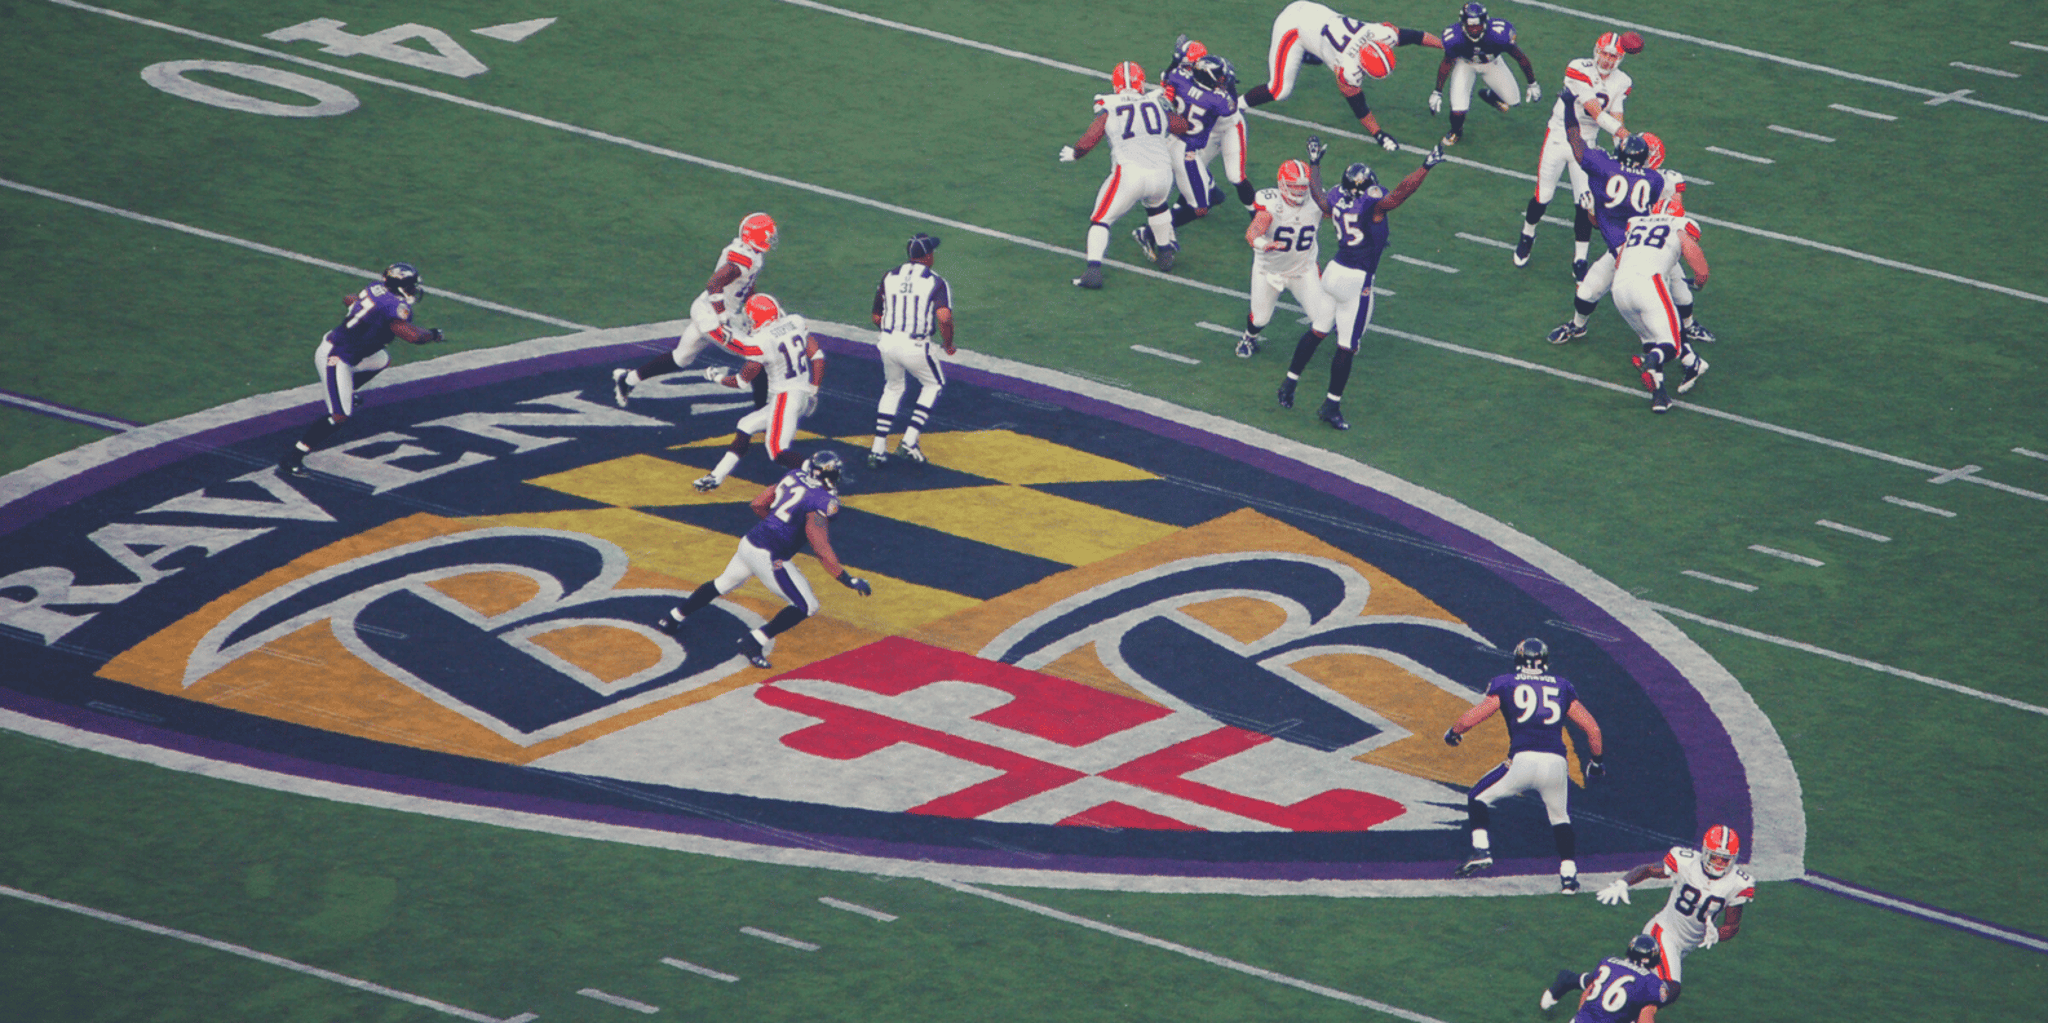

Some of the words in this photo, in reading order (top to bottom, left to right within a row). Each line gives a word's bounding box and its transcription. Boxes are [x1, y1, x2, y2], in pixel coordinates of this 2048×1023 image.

[1115, 102, 1162, 139] 70
[1604, 174, 1650, 213] 90
[900, 282, 913, 293] 31
[778, 334, 808, 380] 12
[769, 475, 806, 523] 52
[1513, 684, 1561, 725] 95
[1675, 883, 1726, 922] 80
[1585, 964, 1635, 1012] 36
